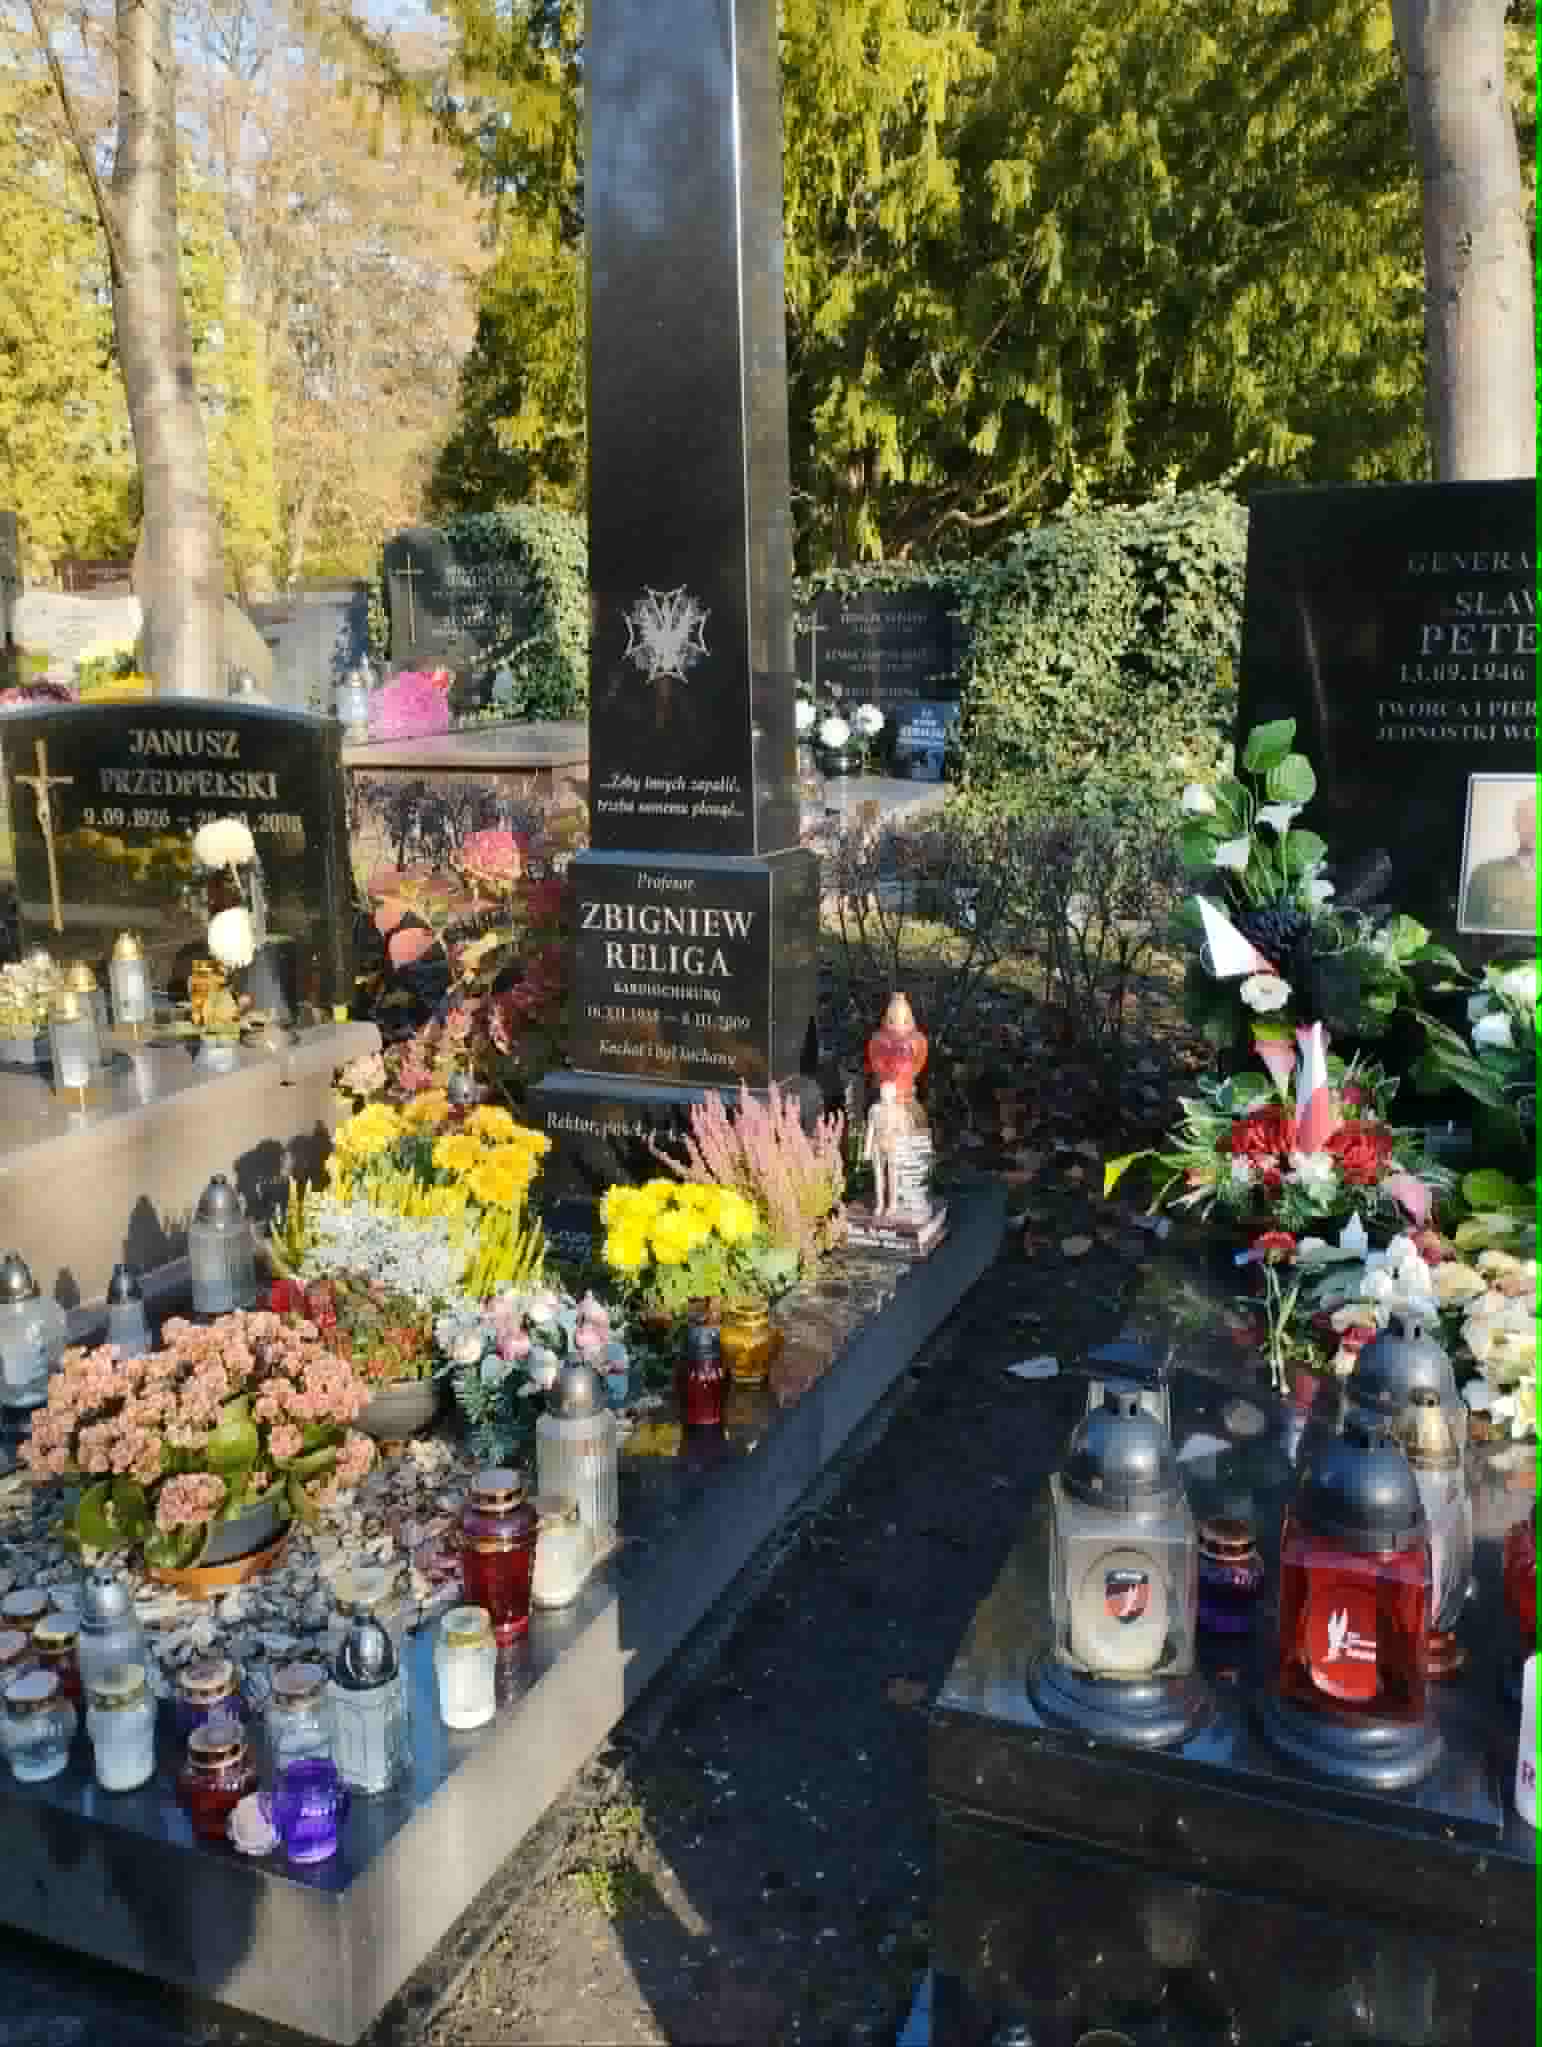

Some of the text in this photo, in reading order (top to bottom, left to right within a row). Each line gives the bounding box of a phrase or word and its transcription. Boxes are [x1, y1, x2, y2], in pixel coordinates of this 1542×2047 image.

[127, 728, 241, 758] JANUSZ
[580, 901, 756, 941] ZBIGNIEW
[604, 942, 735, 977] RELIGA
